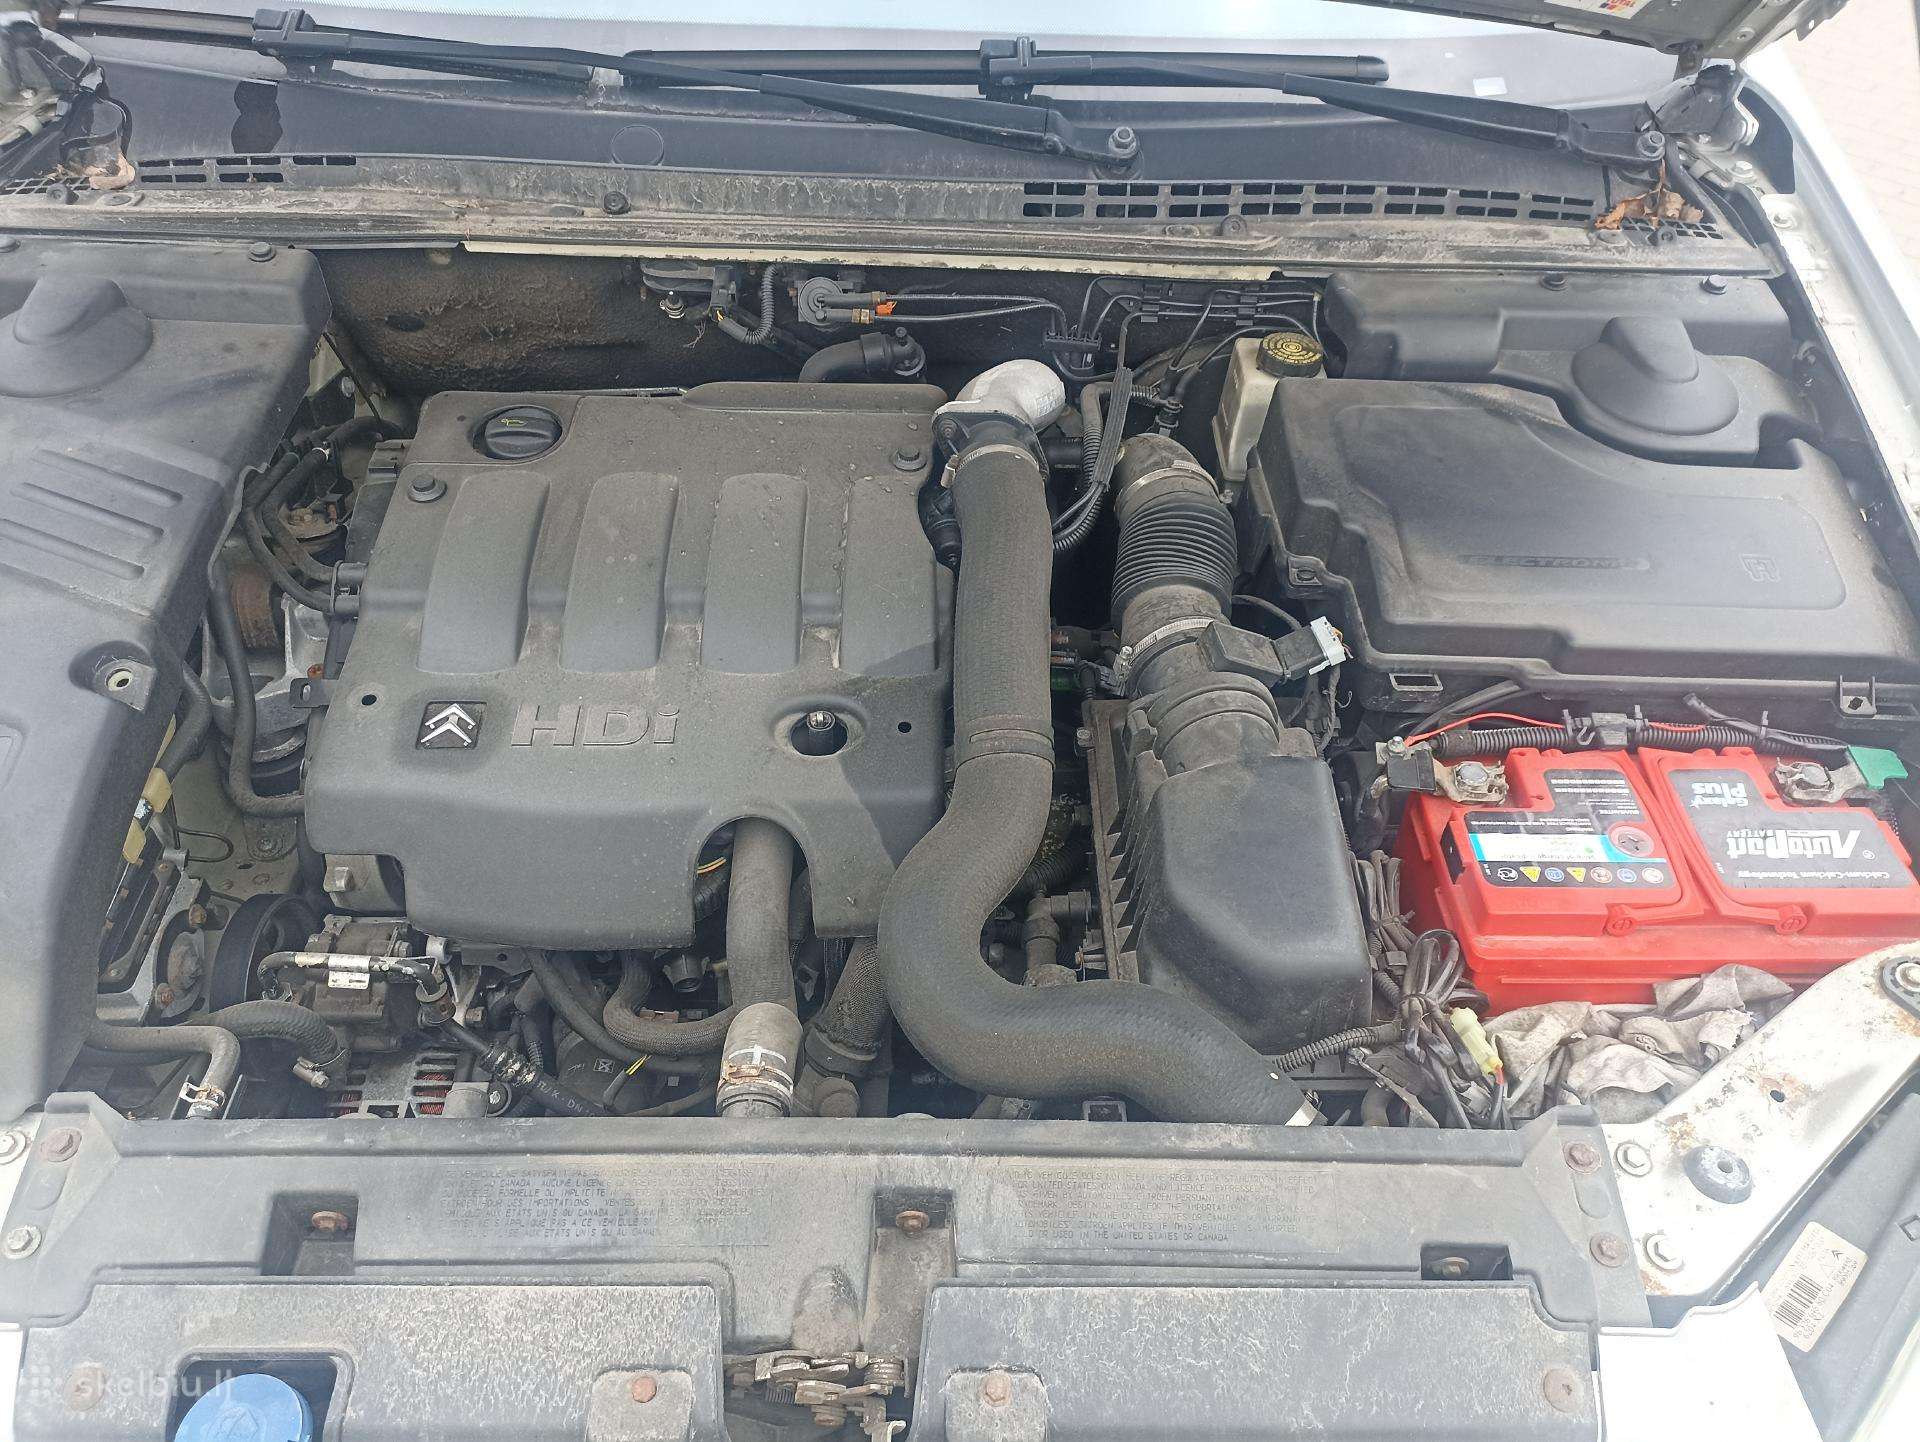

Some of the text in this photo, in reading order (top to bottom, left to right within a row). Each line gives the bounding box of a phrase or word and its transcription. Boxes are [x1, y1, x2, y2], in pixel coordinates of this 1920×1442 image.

[511, 703, 680, 747] HDi
[1690, 782, 1748, 796] Plus
[1726, 828, 1774, 838] BATTERY
[1726, 829, 1861, 860] AutoPart
